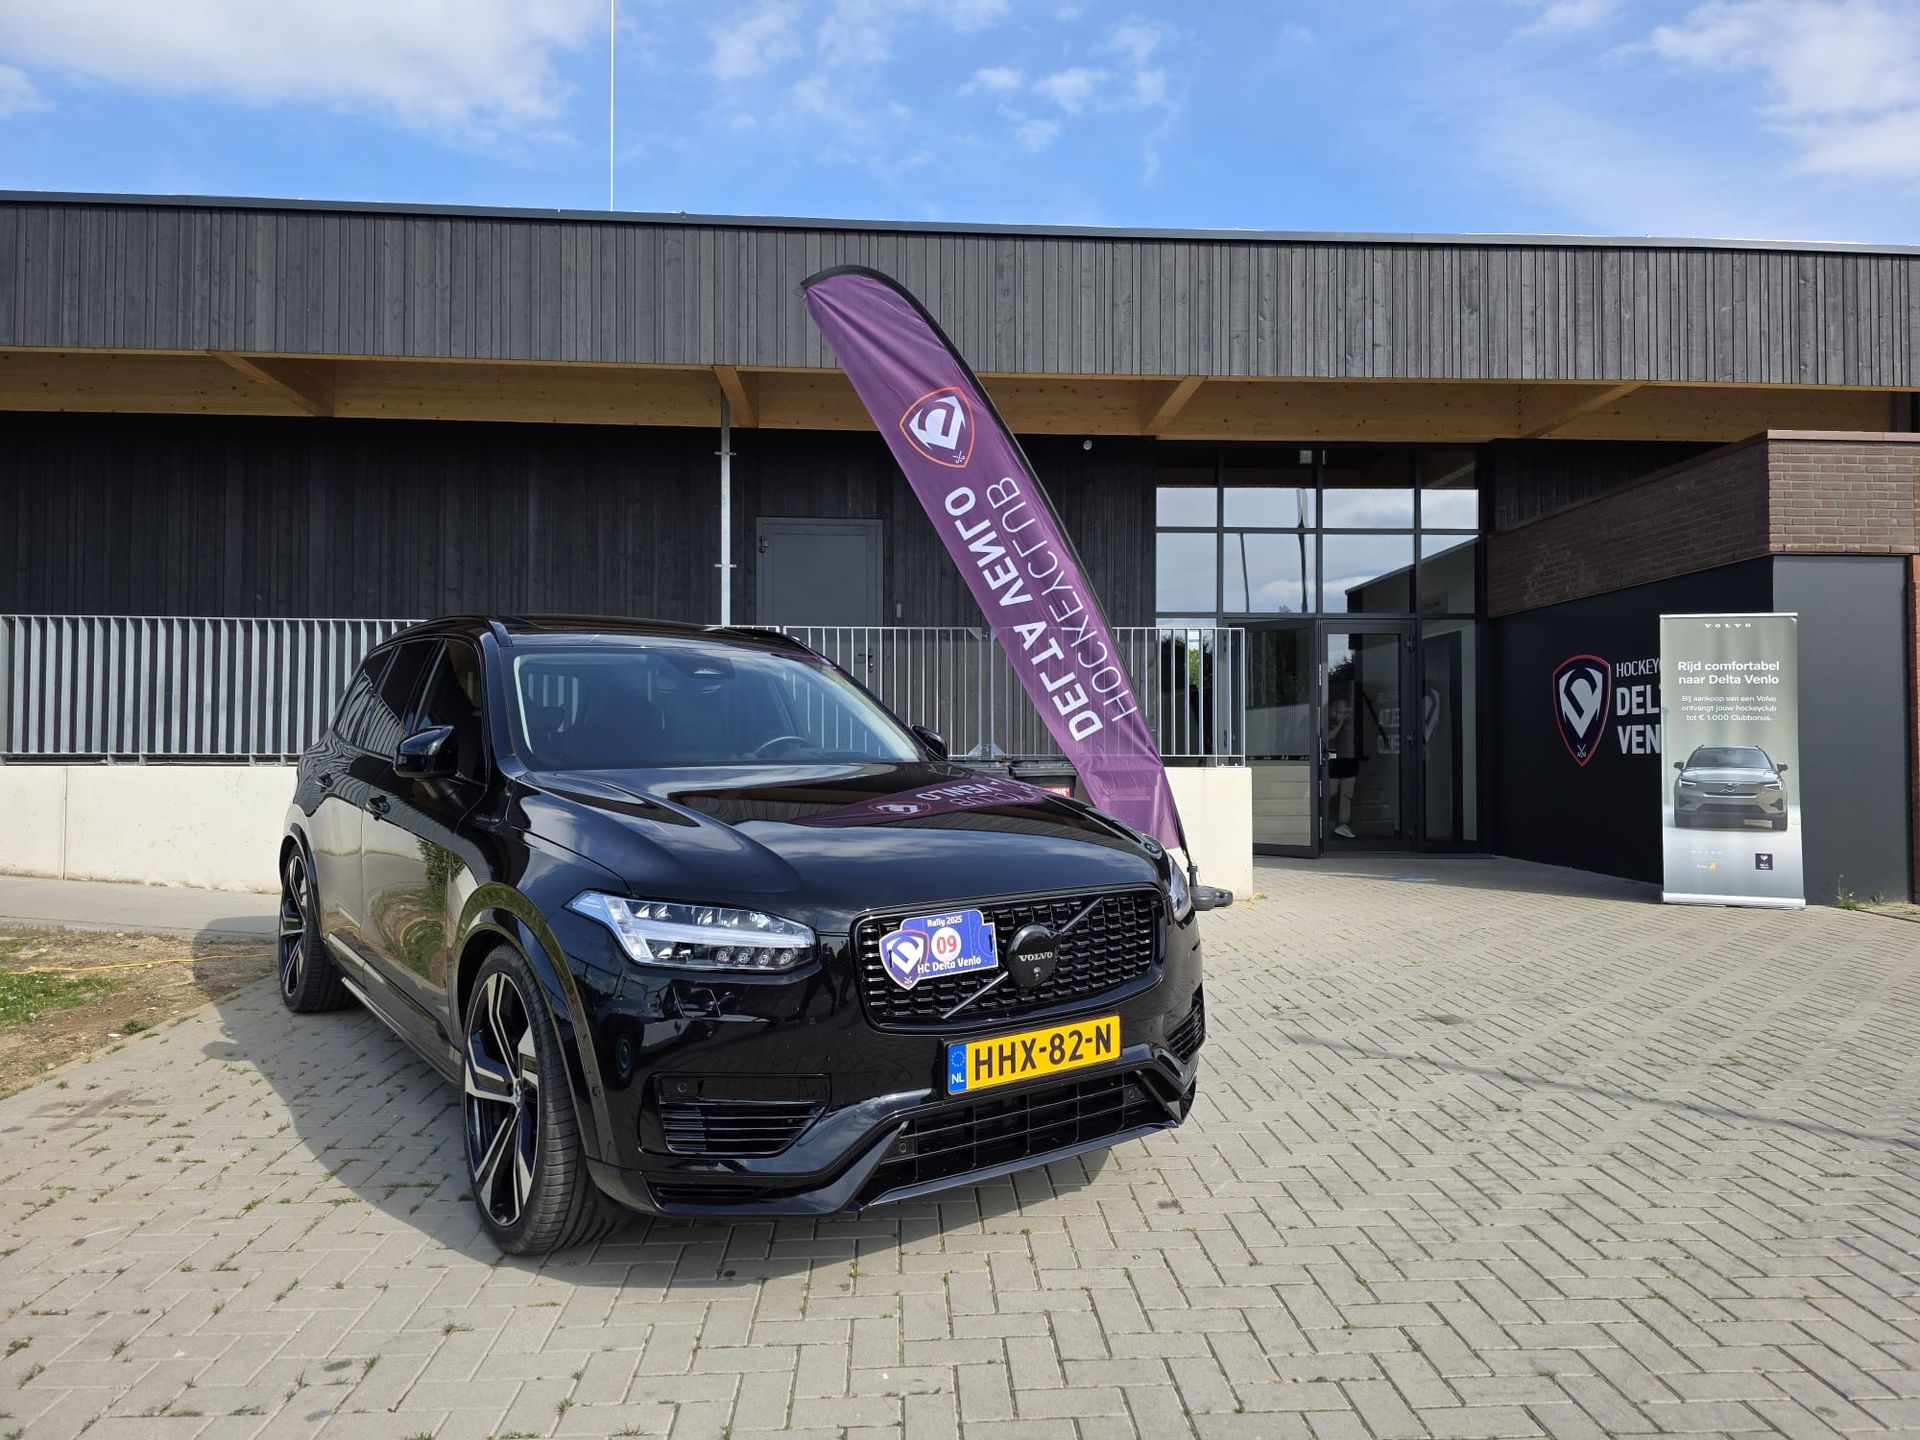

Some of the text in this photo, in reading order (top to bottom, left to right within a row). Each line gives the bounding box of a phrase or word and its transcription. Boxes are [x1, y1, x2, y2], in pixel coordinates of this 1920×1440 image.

[1616, 658, 1661, 678] HOCKEY
[1678, 661, 1780, 673] Rijd comfortabel
[1678, 674, 1780, 684] naar Delta Venlo
[1616, 683, 1661, 716] DEL
[1693, 695, 1725, 703] aankoop
[1681, 704, 1777, 713] ontvangt jouw hockeyclub
[927, 915, 963, 928] Rally 2025
[936, 935, 957, 955] 09
[1018, 951, 1053, 962] VOLVO
[917, 956, 982, 974] HC Delta Venlo
[951, 1023, 1112, 1085] NL HHX-82-N
